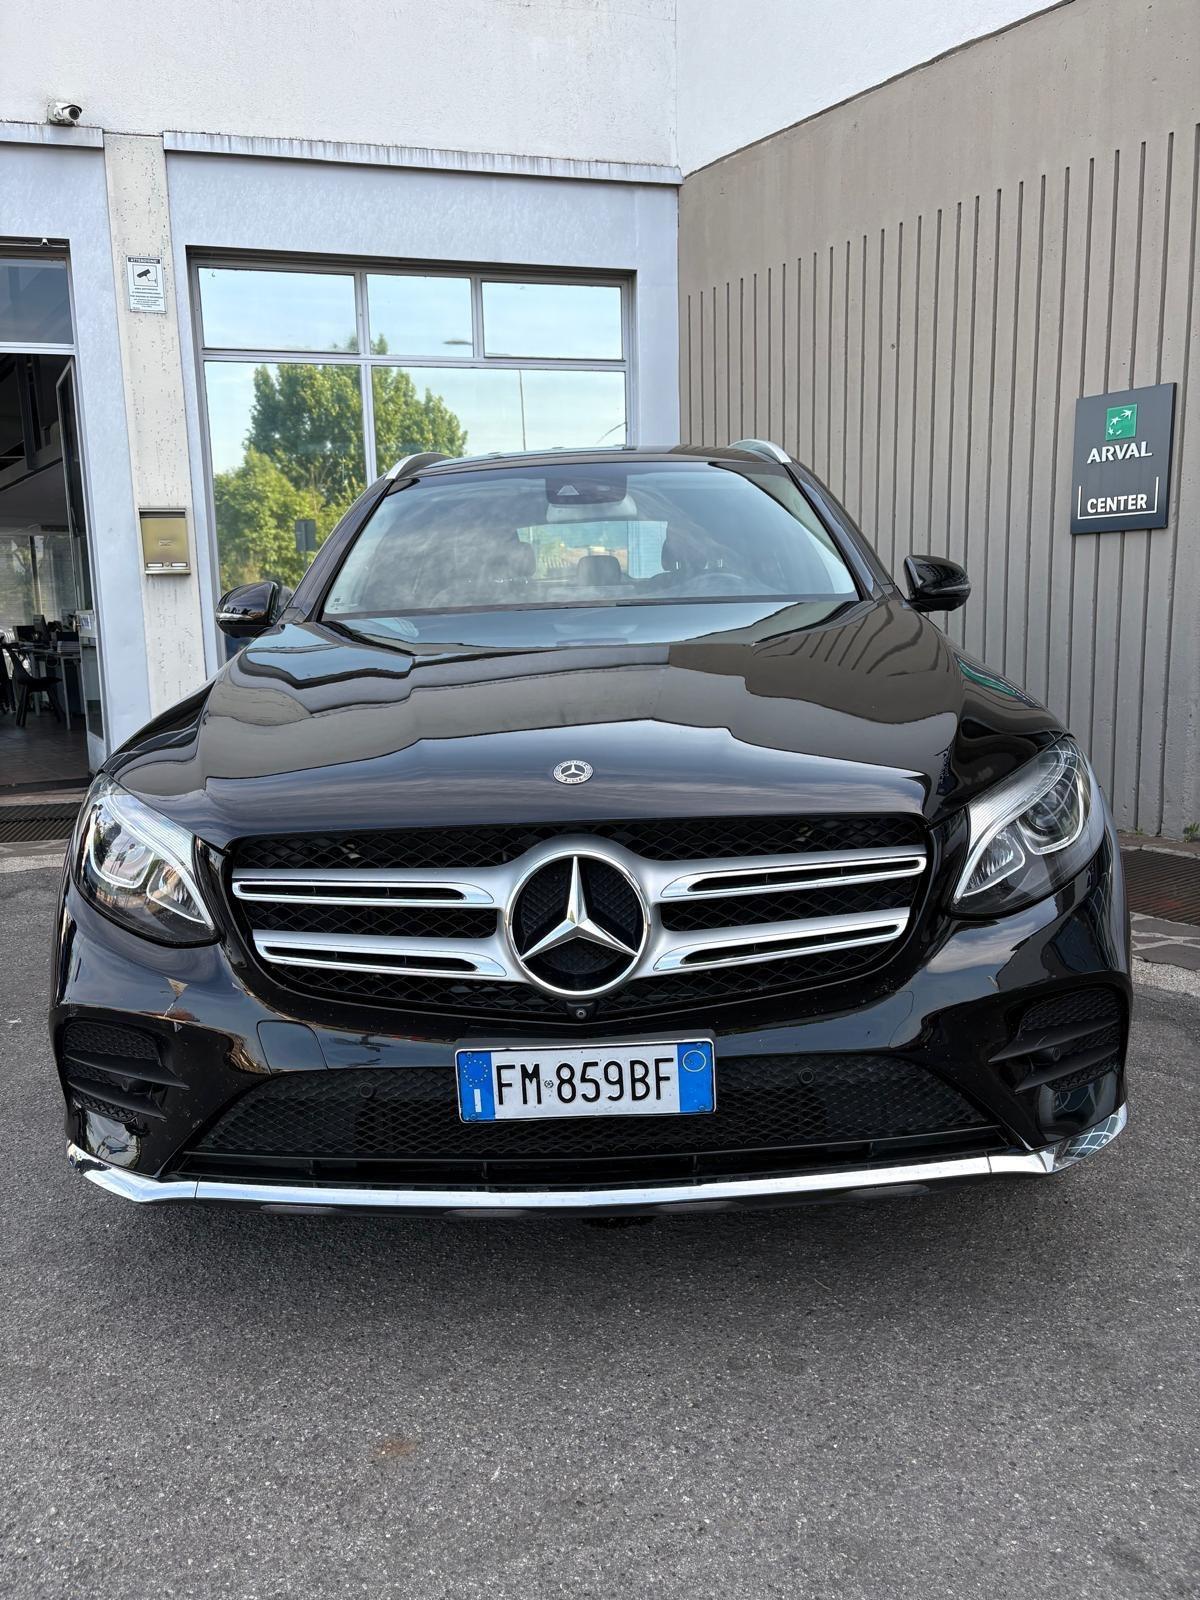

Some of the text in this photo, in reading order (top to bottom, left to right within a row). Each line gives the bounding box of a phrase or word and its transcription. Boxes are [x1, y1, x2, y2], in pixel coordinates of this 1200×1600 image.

[1087, 441, 1153, 464] ARVAL
[1087, 494, 1148, 513] CENTER
[496, 1057, 674, 1105] FM 859BF
